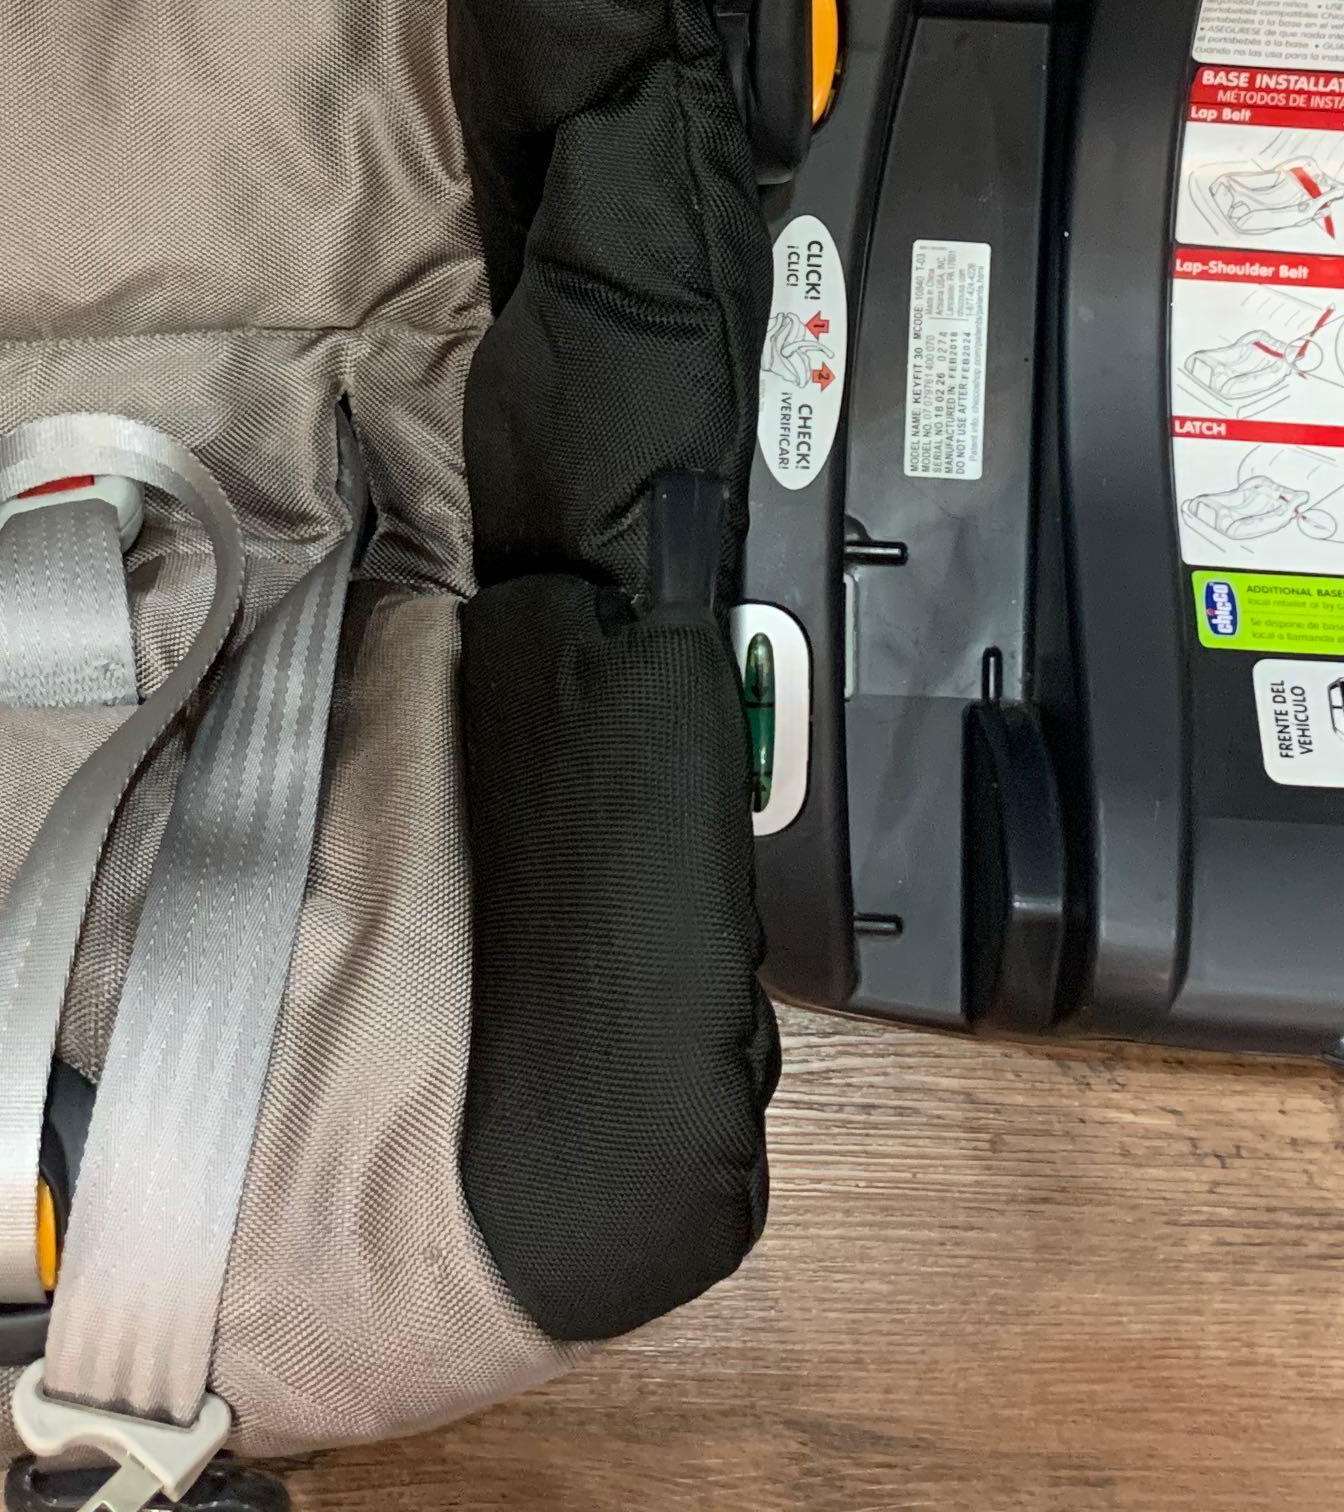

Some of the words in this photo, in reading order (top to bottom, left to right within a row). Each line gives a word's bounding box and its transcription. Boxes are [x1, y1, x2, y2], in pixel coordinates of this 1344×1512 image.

[1202, 71, 1250, 88] BASE
[1289, 94, 1307, 107] DE
[1191, 105, 1217, 122] Lap
[1222, 108, 1251, 121] Belt
[804, 240, 823, 300] CLICK!
[1176, 259, 1275, 277] Lap-Shoulder
[1279, 265, 1309, 279] Belt
[914, 347, 922, 359] 30
[912, 363, 922, 403] KEYFIT
[957, 383, 968, 413] AFTER
[944, 397, 956, 474] MANUFACTURED
[957, 416, 966, 435] USE
[1174, 420, 1227, 436] LATCH
[794, 403, 812, 470] CHECK!
[910, 439, 919, 471] MODEL
[956, 438, 965, 457] NOT
[955, 460, 965, 474] DO
[1246, 584, 1312, 597] ADDITIONAL
[1207, 584, 1234, 634] chicco
[1269, 679, 1286, 703] DEL
[1273, 709, 1294, 758] FRENTE
